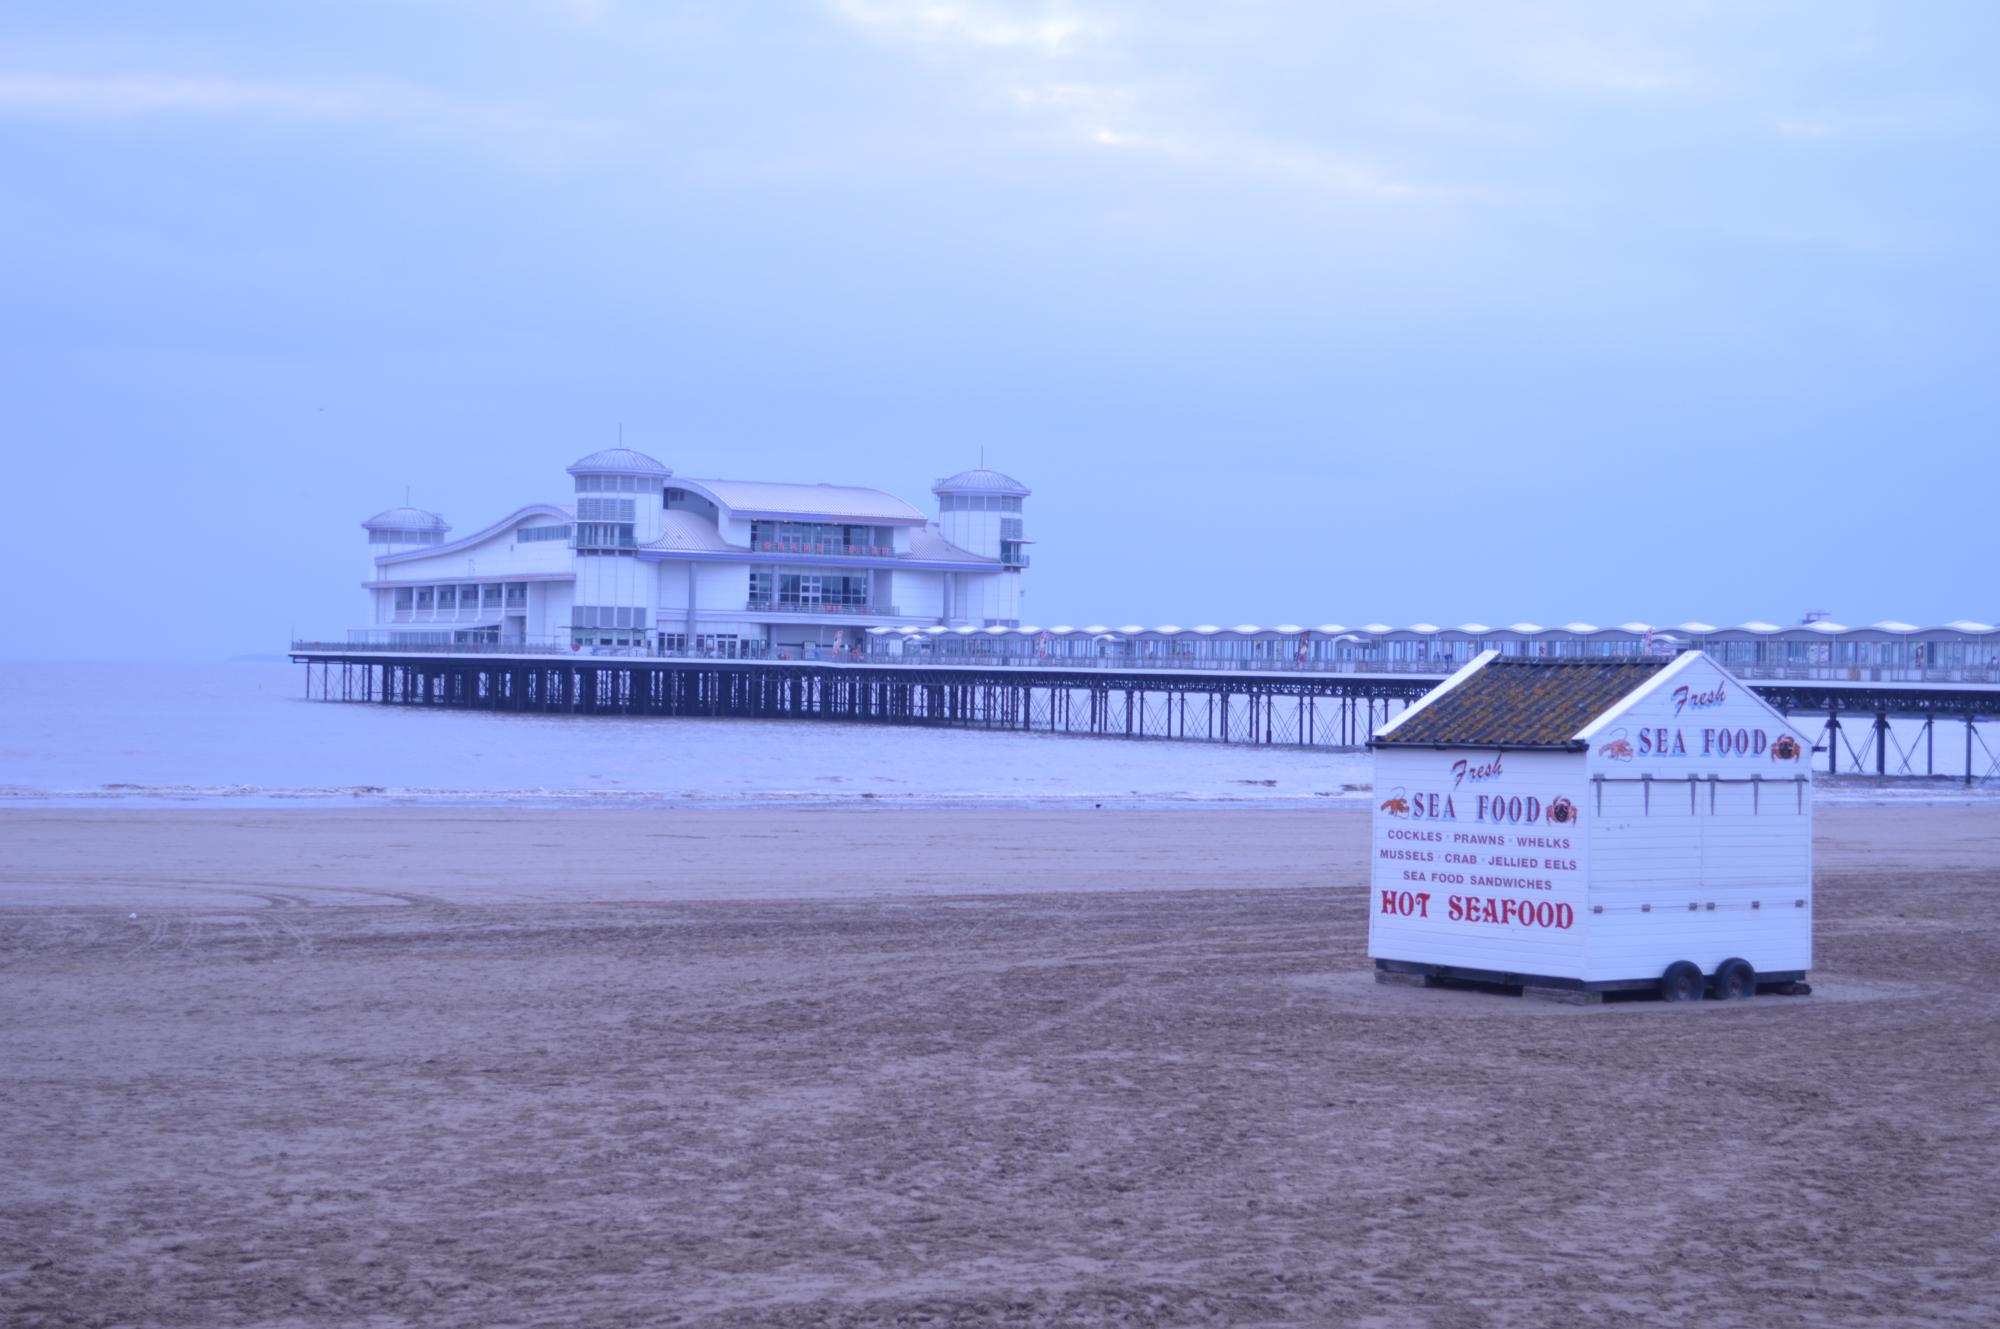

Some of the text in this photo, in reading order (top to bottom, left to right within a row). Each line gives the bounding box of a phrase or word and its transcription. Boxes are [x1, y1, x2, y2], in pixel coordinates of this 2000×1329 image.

[1673, 680, 1726, 716] Fresh
[1637, 727, 1767, 756] SEA FOOD
[1452, 754, 1503, 788] Fresh
[1412, 792, 1541, 823] SEA FOOD
[1388, 830, 1570, 849] COCKLES PRAWNS WHELKS
[1380, 849, 1577, 871] MUSSELS CRAB JELLIED EELS
[1403, 870, 1552, 890] SEA FOOD SANDWICHES
[1381, 890, 1574, 930] HOT SEAFOOD
